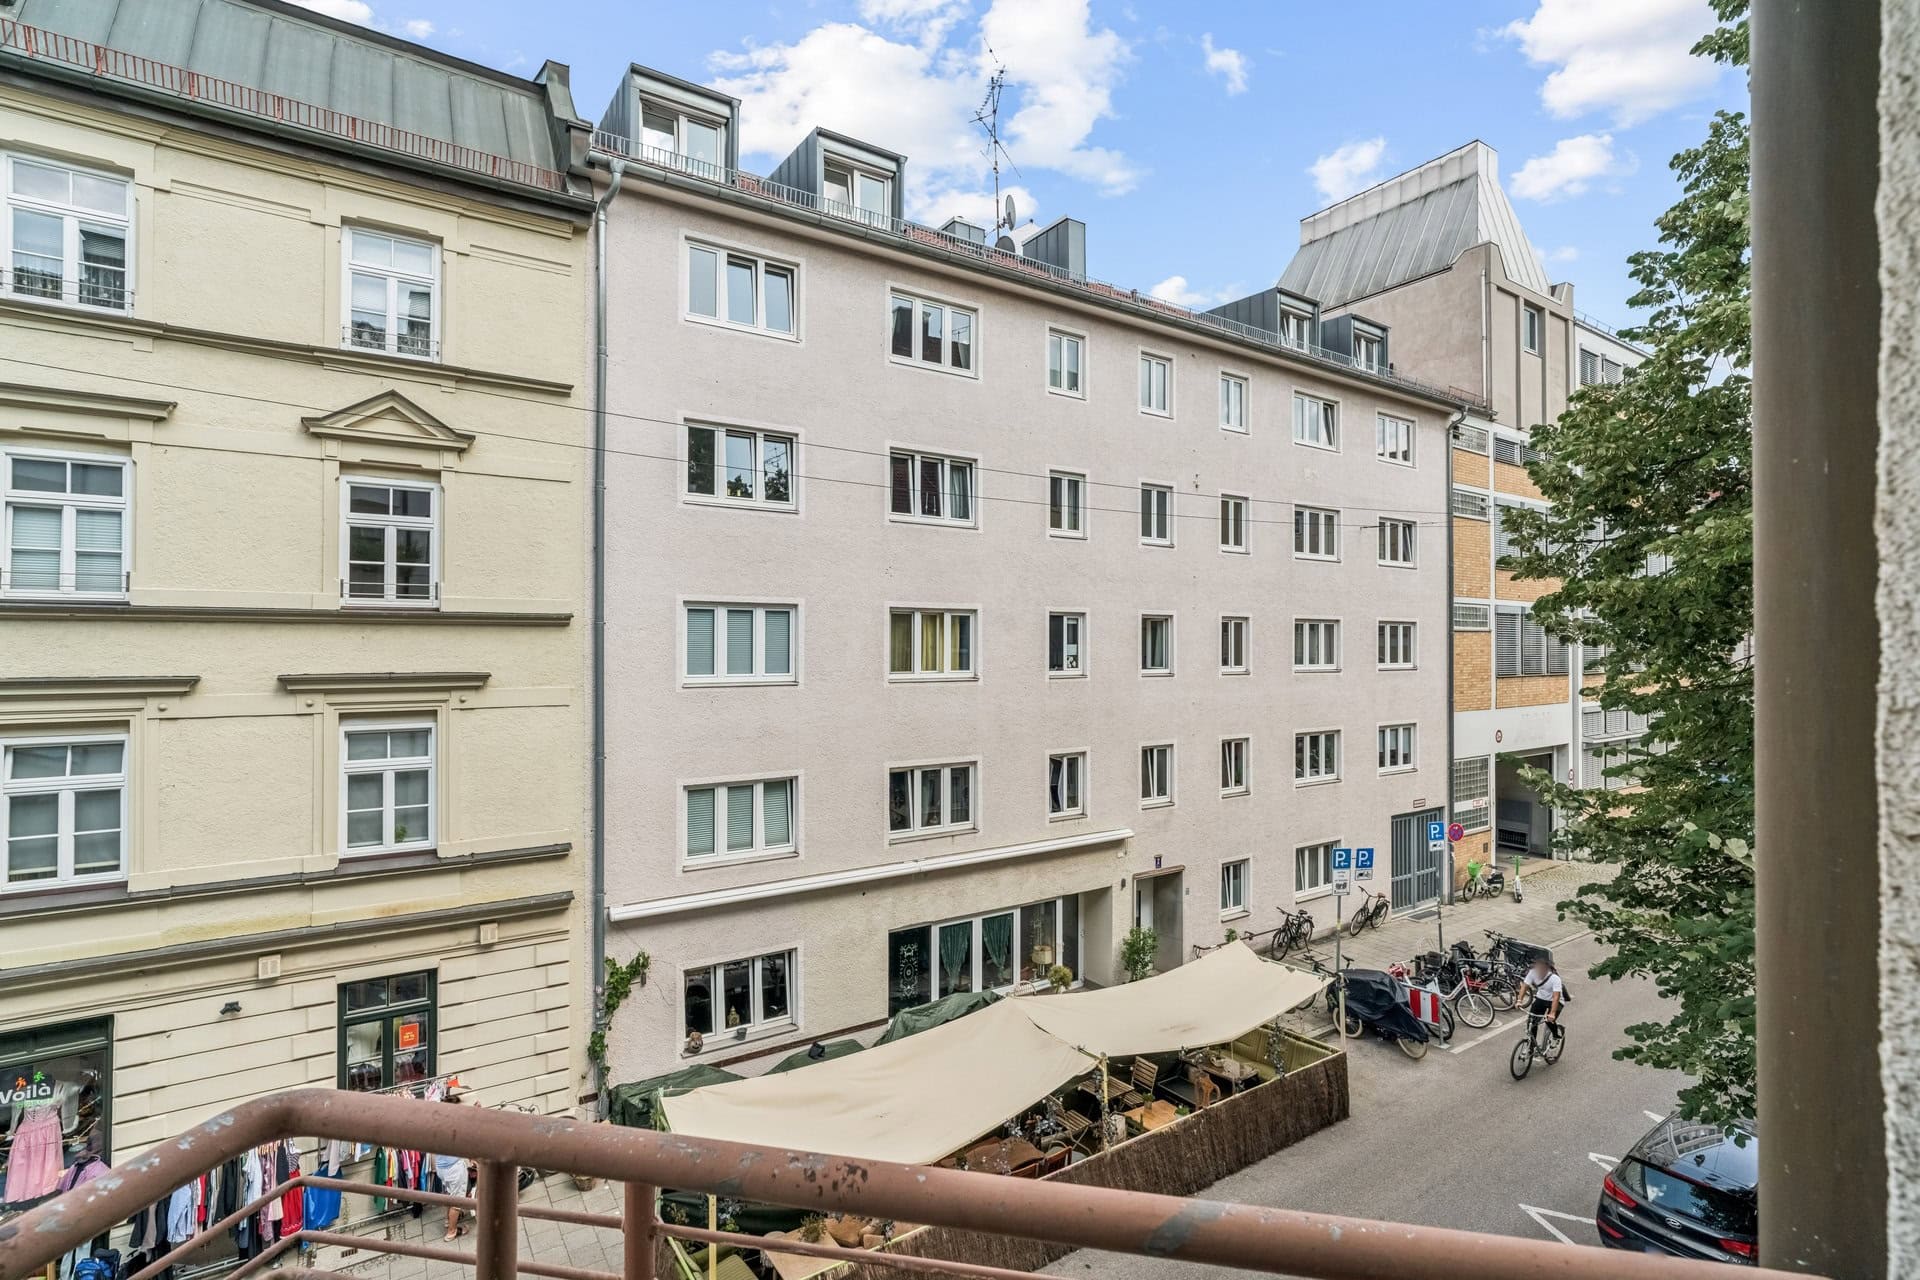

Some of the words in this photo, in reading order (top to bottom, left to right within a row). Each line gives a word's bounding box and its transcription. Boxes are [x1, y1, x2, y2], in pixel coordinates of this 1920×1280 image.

[1430, 824, 1440, 839] P
[1335, 851, 1346, 867] P
[1358, 850, 1369, 867] P
[0, 1082, 51, 1104] Voilà
